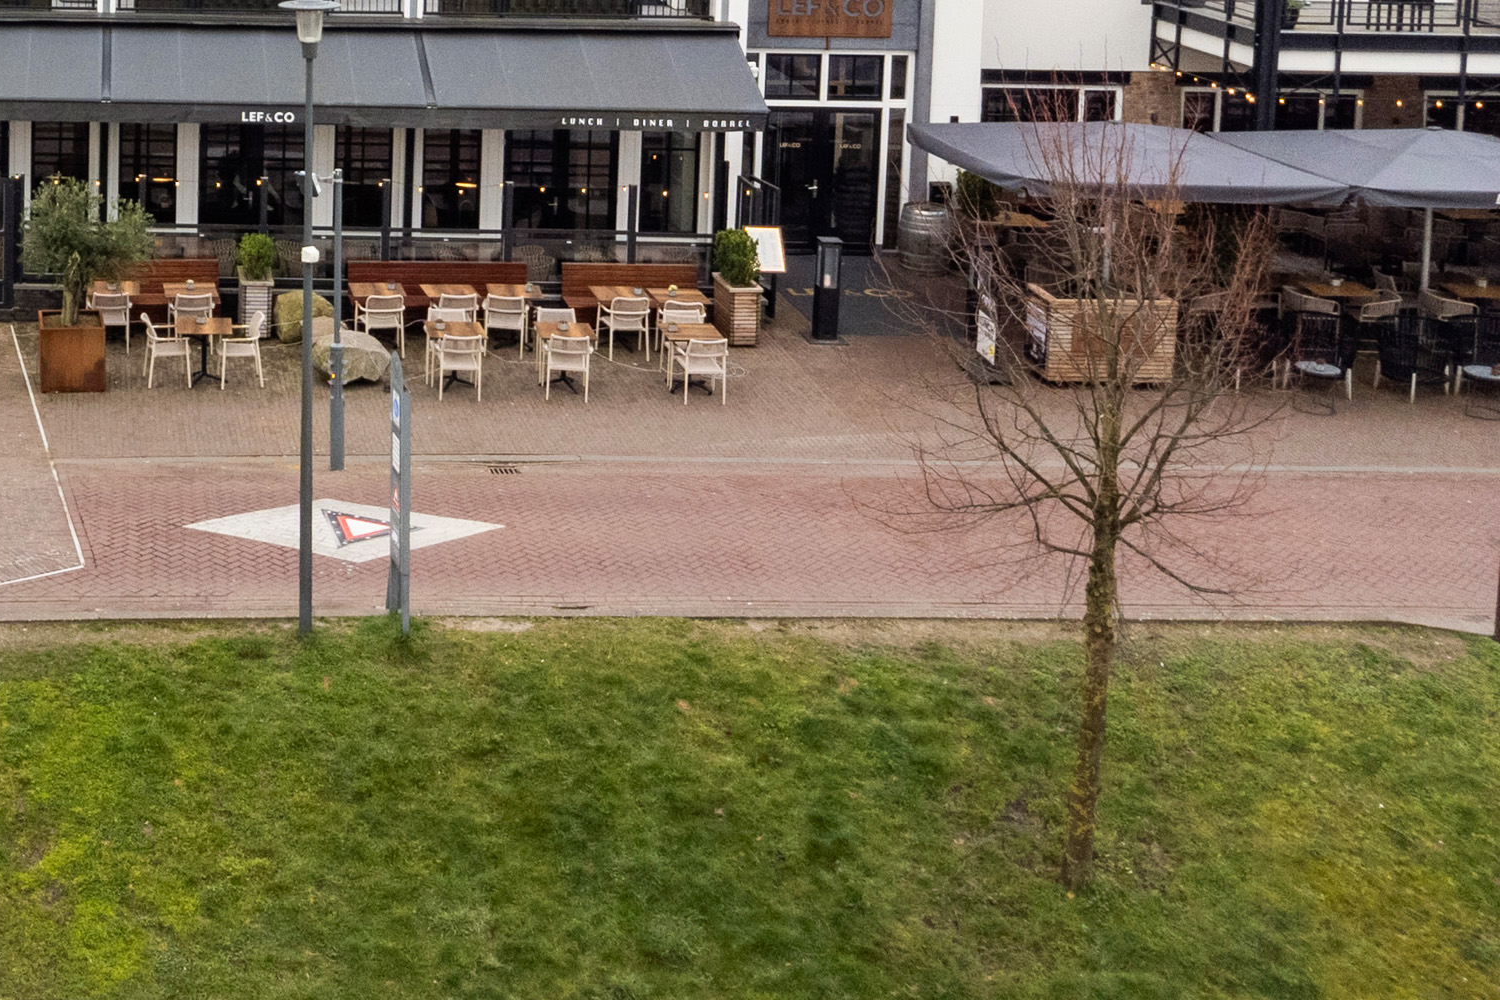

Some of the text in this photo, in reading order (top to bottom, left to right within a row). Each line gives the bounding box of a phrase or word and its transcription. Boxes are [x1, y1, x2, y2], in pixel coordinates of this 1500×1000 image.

[561, 117, 751, 128] LUNCH DINER BORREL
